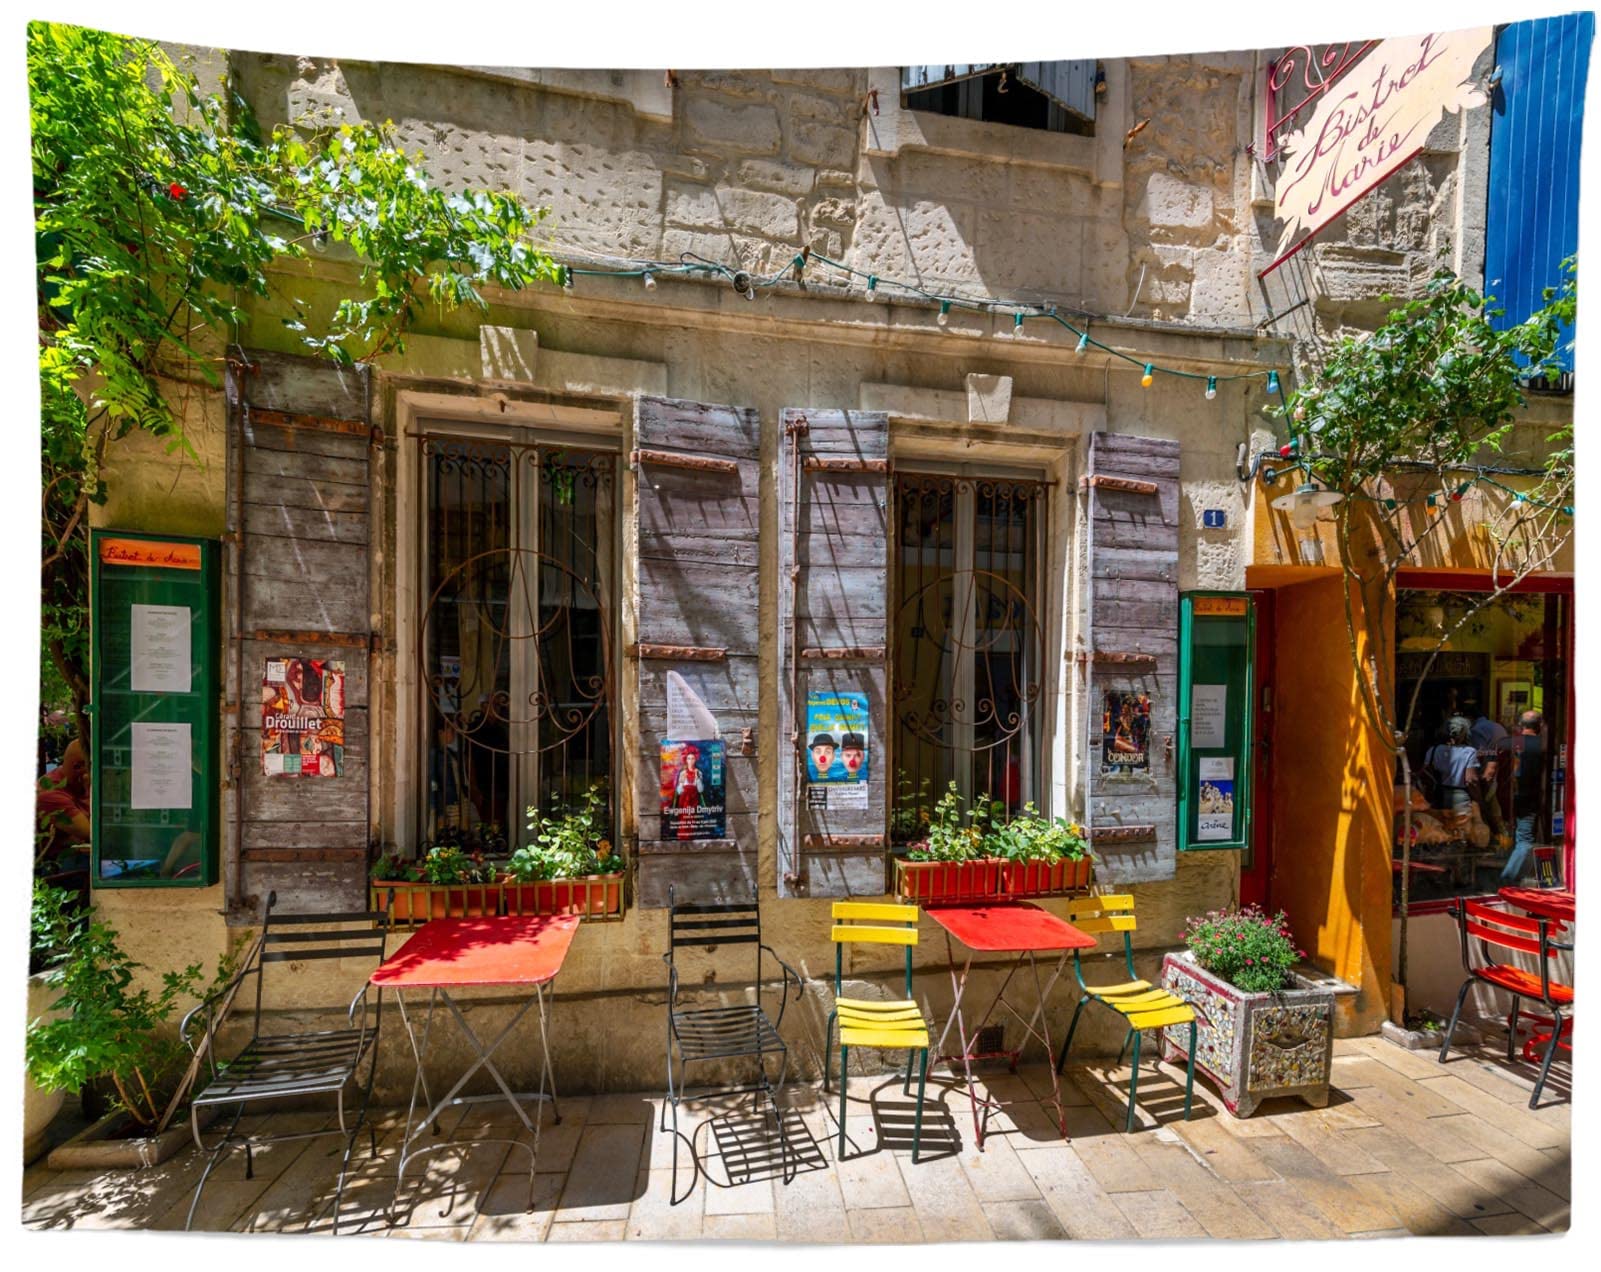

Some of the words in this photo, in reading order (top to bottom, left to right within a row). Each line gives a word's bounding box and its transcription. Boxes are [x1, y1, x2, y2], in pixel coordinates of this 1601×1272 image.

[1280, 32, 1448, 207] Bistrot
[1357, 104, 1403, 152] de
[1308, 111, 1431, 215] Marie
[1210, 511, 1217, 526] 1
[266, 716, 322, 730] Drouillet
[1108, 752, 1144, 763] CONDOR
